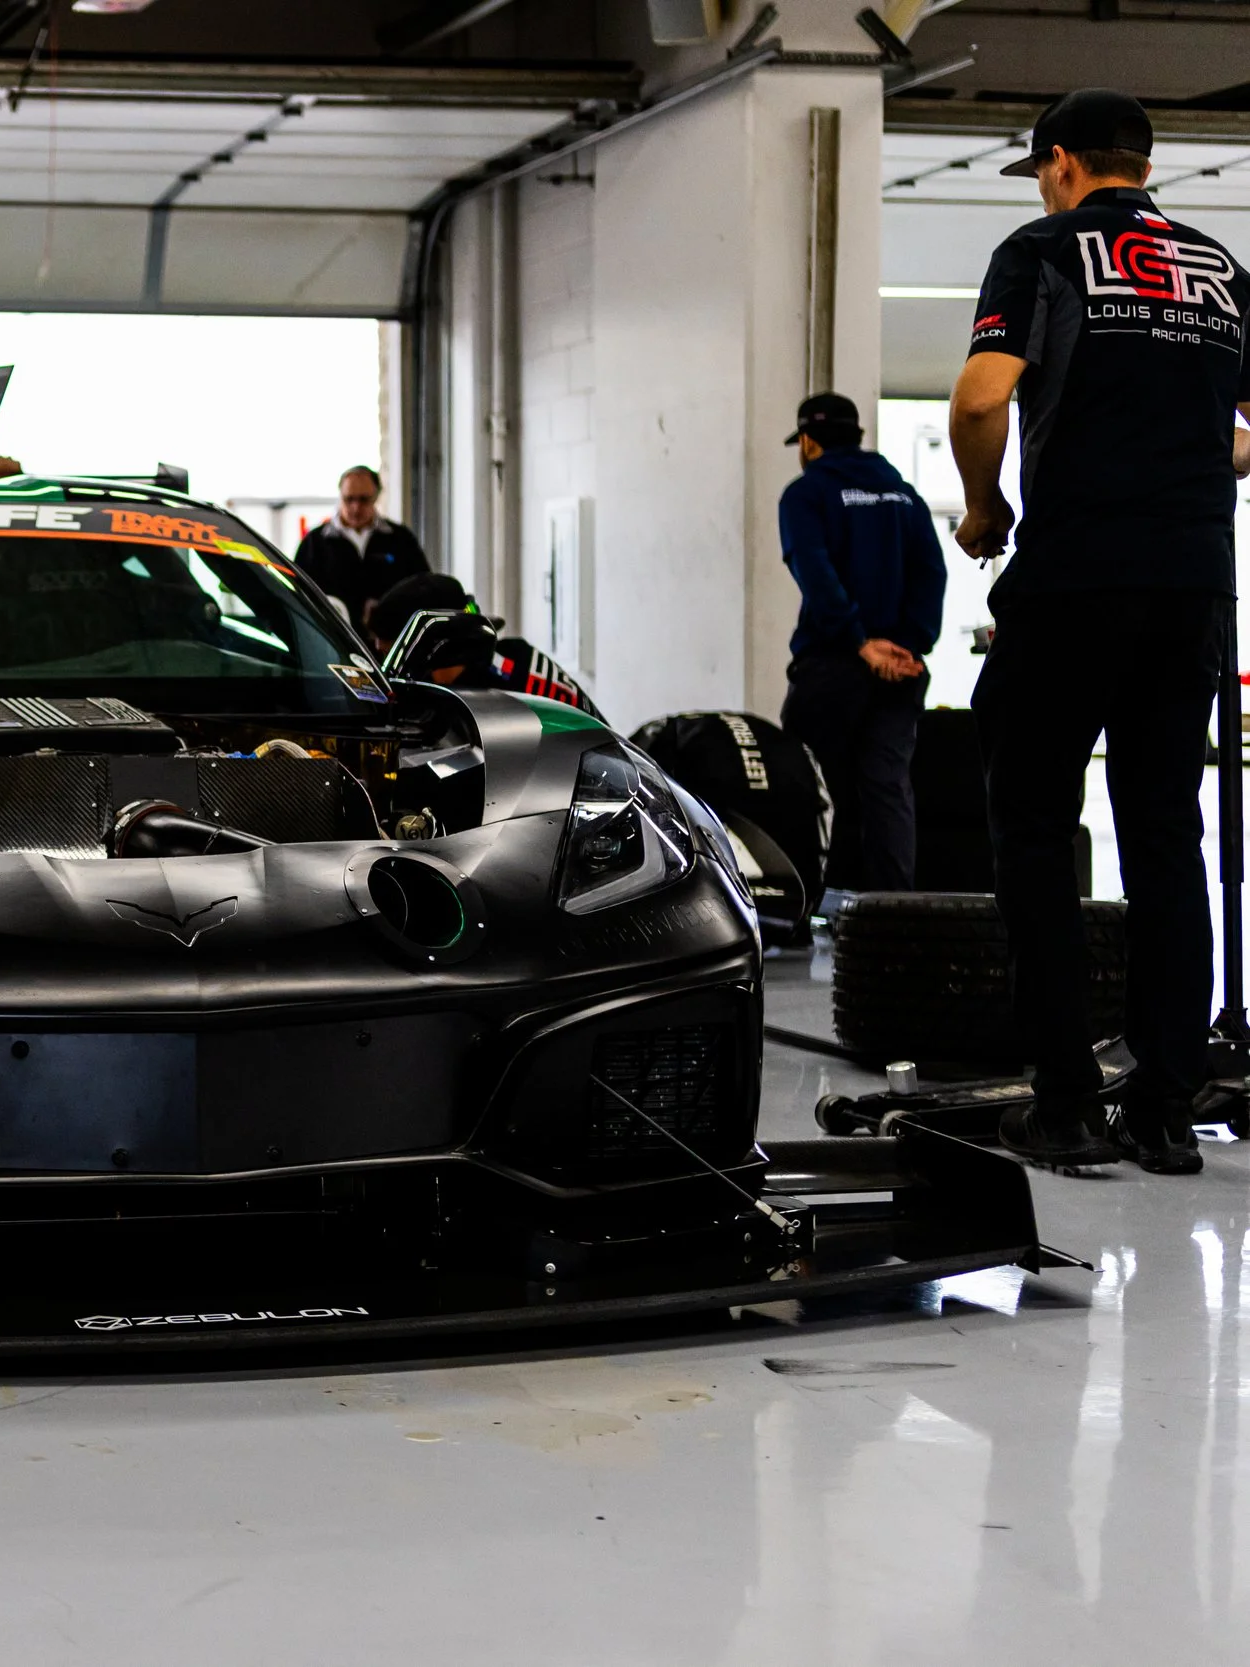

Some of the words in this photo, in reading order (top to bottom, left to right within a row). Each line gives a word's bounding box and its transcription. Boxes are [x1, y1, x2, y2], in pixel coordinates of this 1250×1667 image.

[1076, 231, 1240, 317] LGR
[1087, 304, 1150, 319] LOUIS
[1163, 308, 1241, 338] GIGLIOTTI
[1152, 327, 1201, 344] RACING
[740, 747, 769, 790] LEFT
[131, 1306, 369, 1327] ZEBULON
